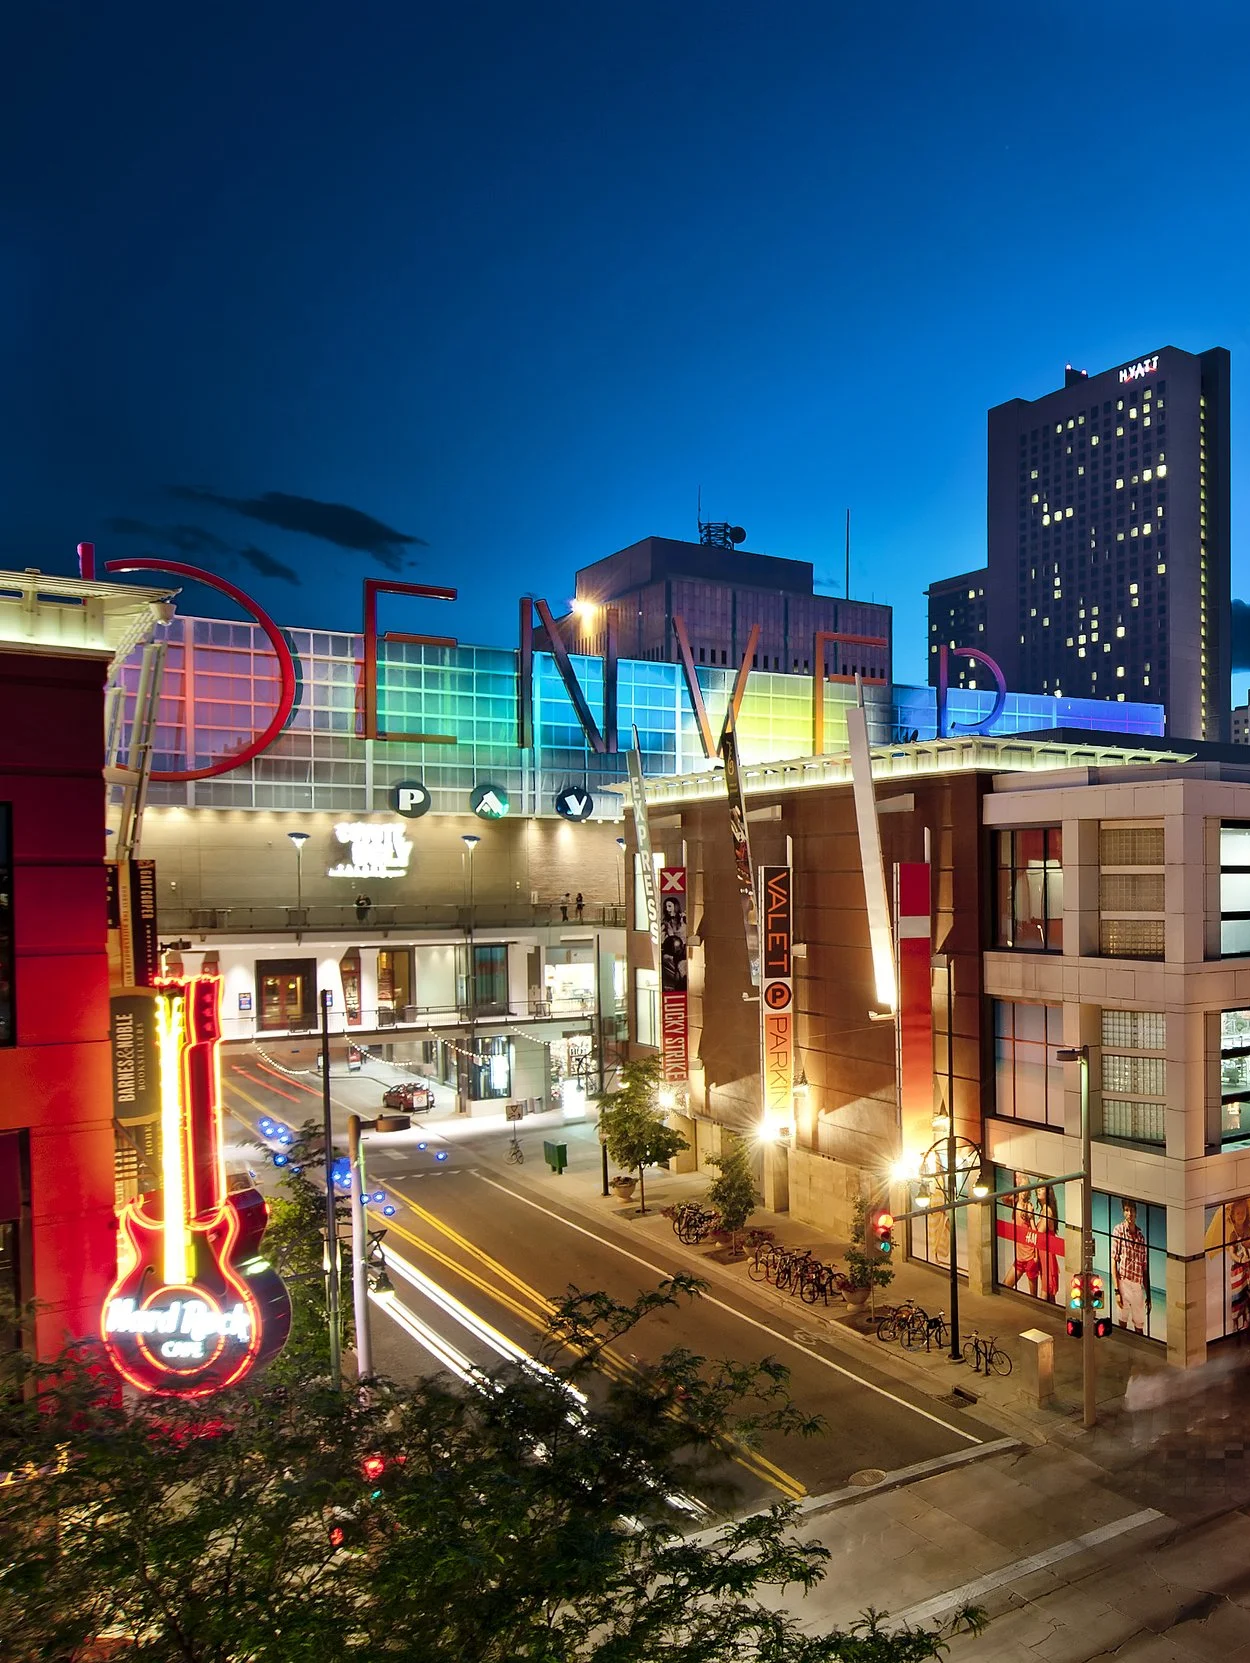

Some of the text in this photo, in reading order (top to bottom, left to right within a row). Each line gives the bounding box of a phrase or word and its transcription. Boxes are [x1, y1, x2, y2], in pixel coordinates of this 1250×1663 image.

[1119, 355, 1159, 383] HYATT
[139, 870, 154, 919] GARY COOPER
[630, 776, 660, 945] EXPRESS
[767, 872, 787, 973] VALET
[136, 1022, 146, 1091] BOOKSELLERS
[663, 994, 686, 1081] LUCKY STRIKE
[768, 1017, 788, 1110] PARKIN
[1025, 1232, 1037, 1245] H&M
